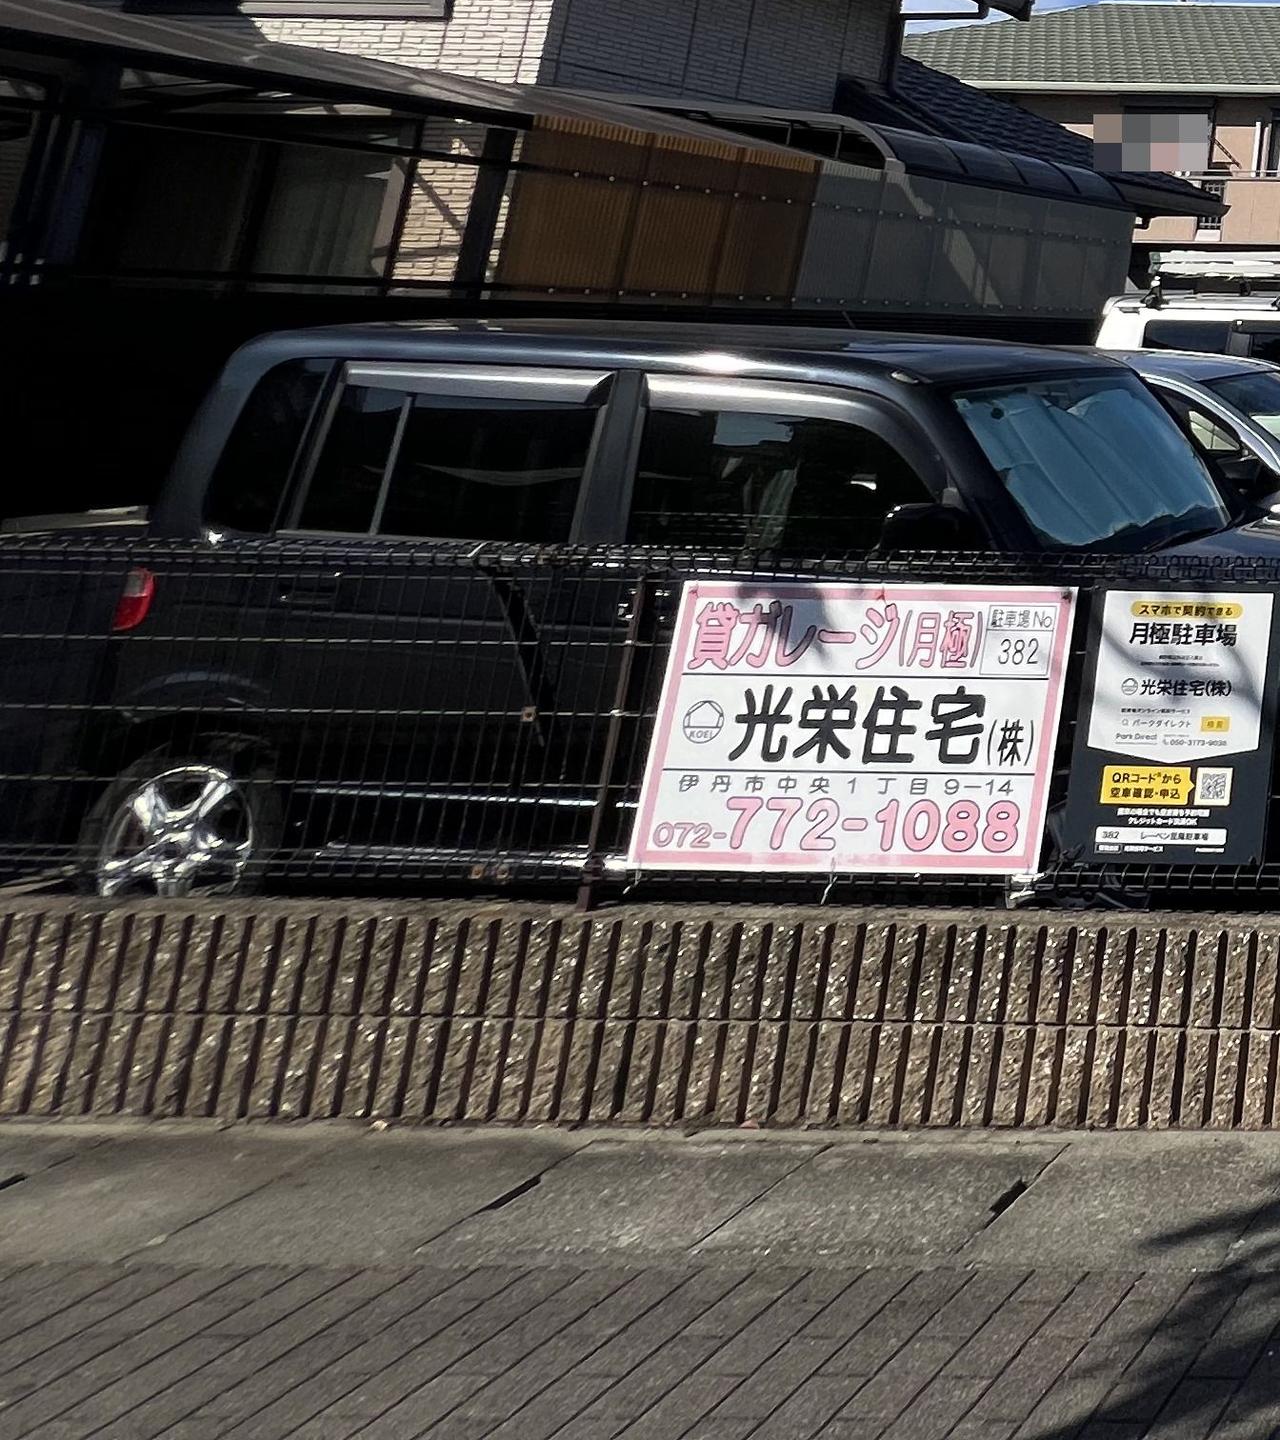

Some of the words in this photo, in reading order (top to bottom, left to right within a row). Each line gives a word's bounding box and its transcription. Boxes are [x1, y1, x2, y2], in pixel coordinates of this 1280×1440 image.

[1129, 622, 1237, 647] 月極駐車場
[998, 637, 1039, 665] 382
[1139, 678, 1232, 697] 光栄住宅(株)
[689, 730, 713, 739] KOEI
[652, 796, 1021, 853] 072-772-1088
